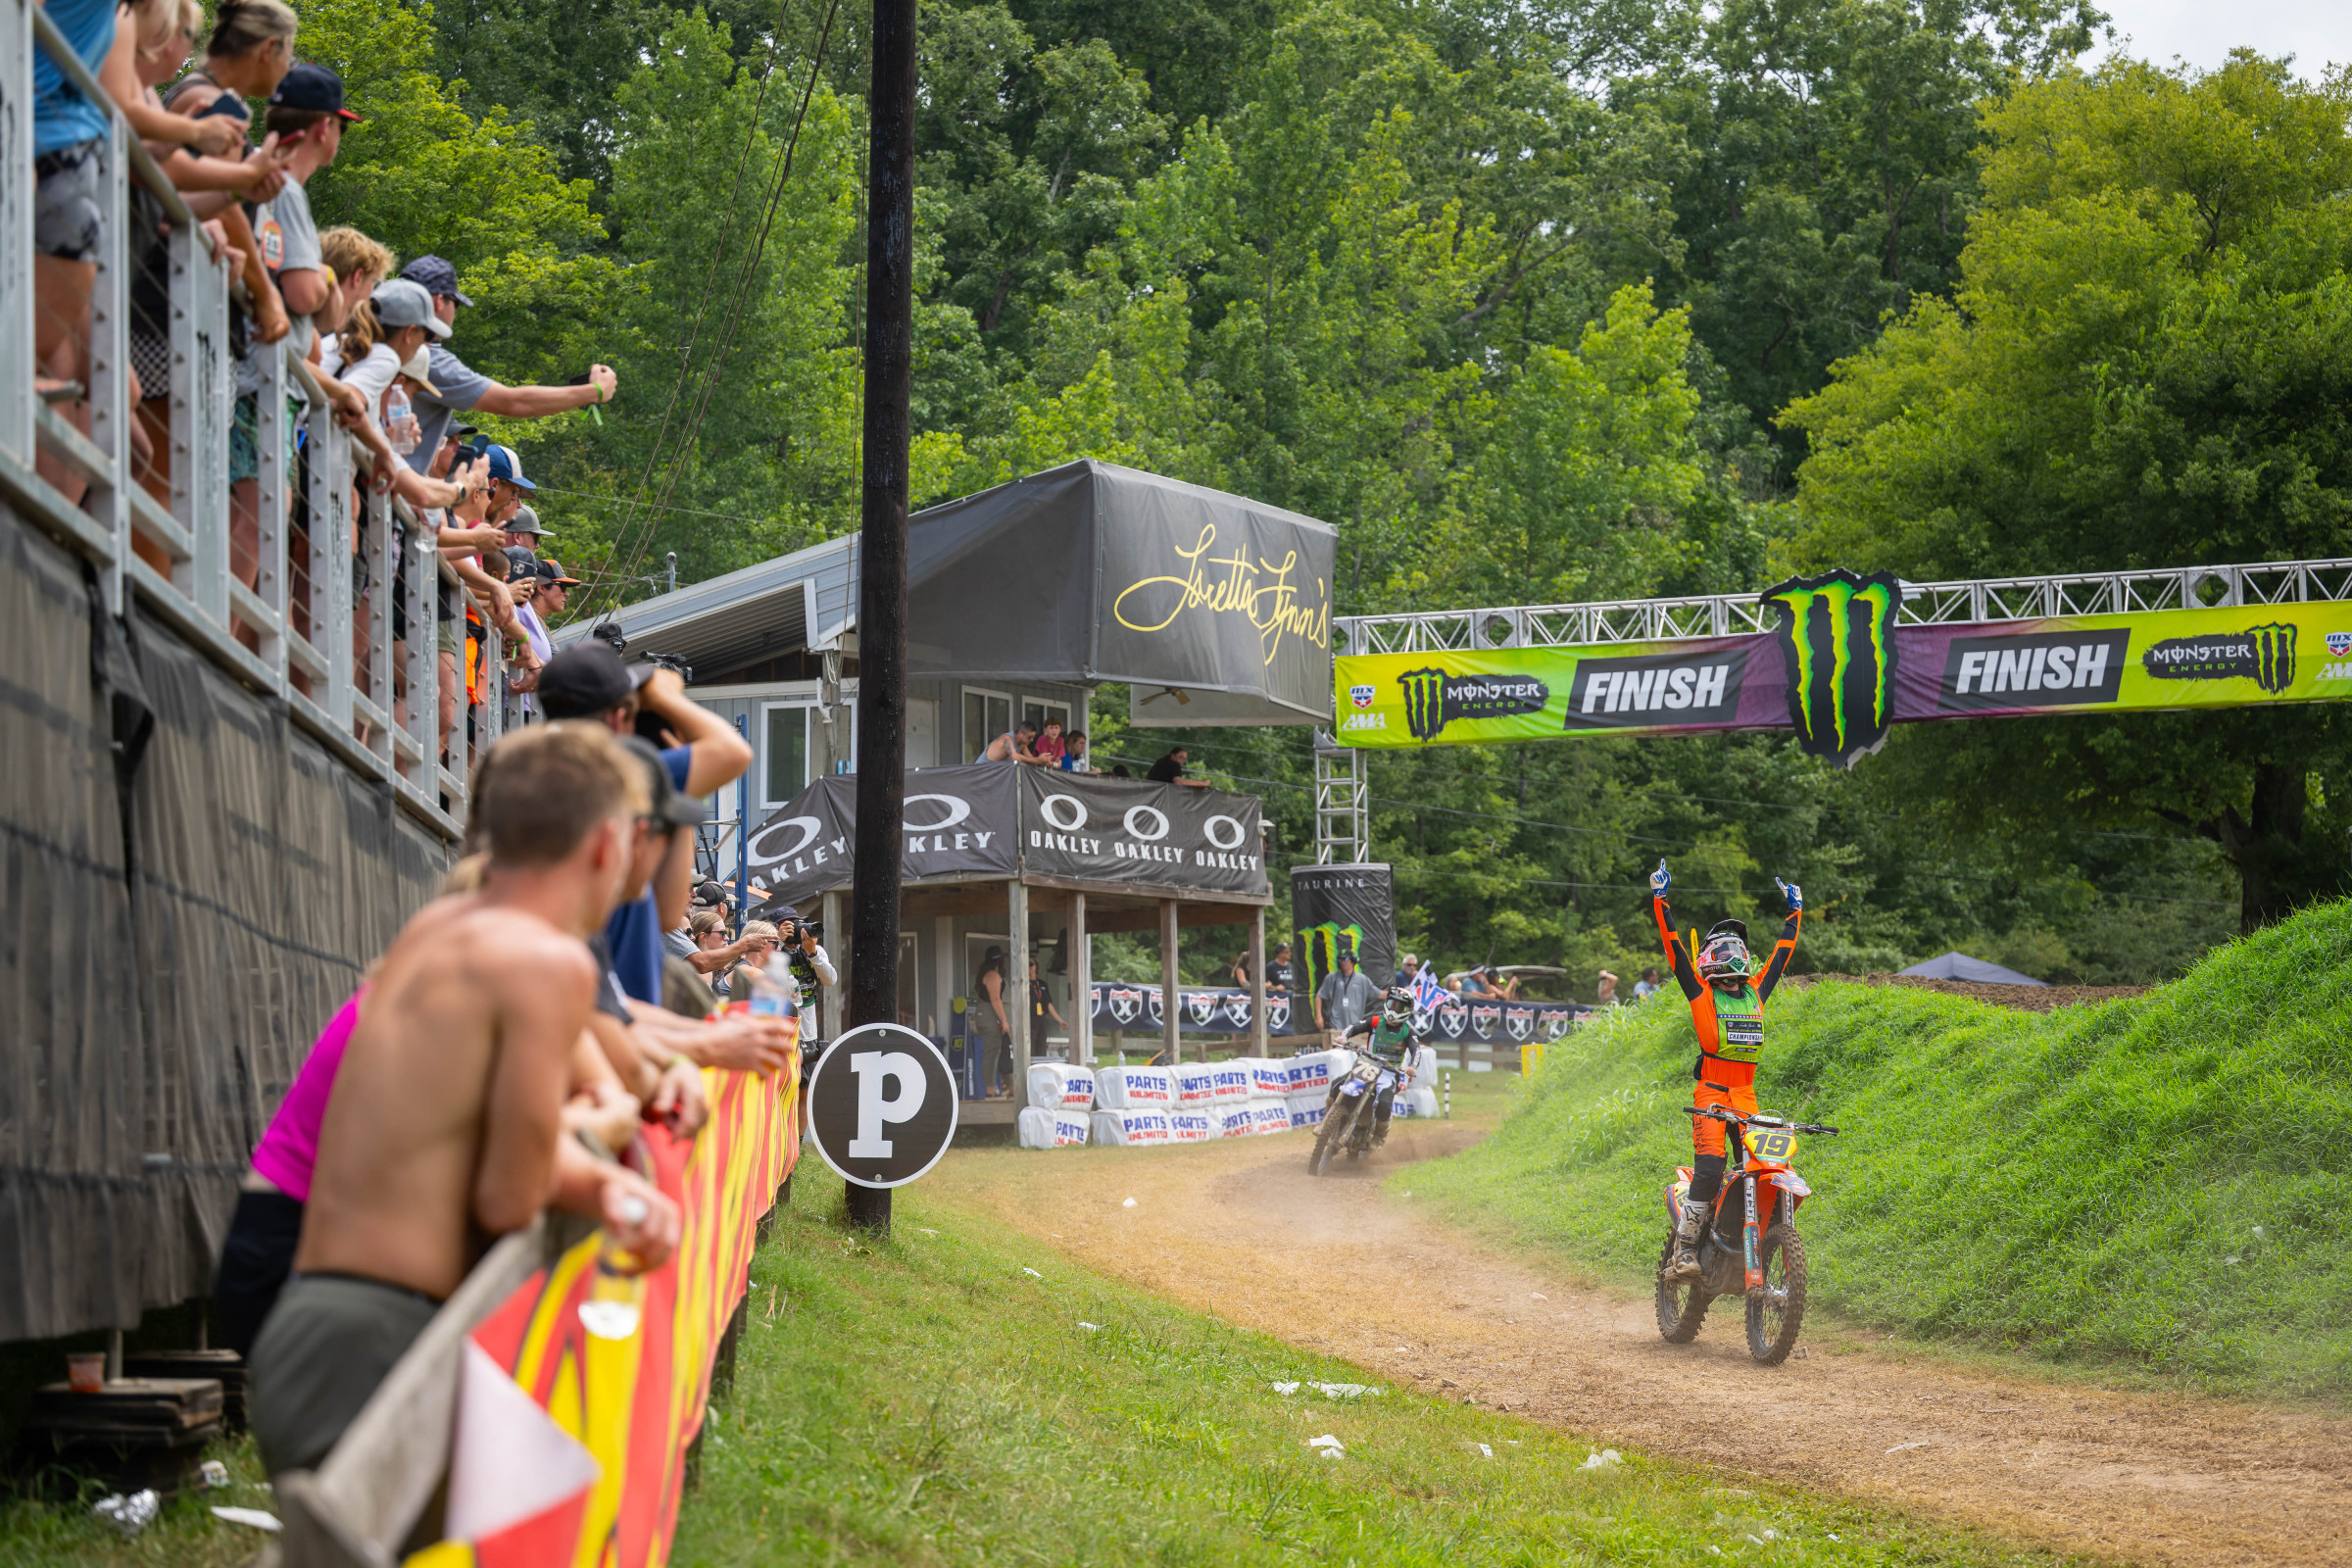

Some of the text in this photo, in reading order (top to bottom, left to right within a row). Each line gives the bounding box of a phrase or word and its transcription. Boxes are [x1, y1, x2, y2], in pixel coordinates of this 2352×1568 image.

[1114, 523, 1260, 631] Loretta
[2152, 641, 2253, 662] MONSTER
[1955, 643, 2111, 695] FINISH
[2169, 661, 2237, 672] ENERGY
[1446, 681, 1542, 702] MONSTER
[1581, 664, 1730, 714] FINISH
[1462, 700, 1528, 711] ENERGY
[1343, 712, 1388, 730] AMA
[908, 831, 993, 854] KLEY
[1030, 830, 1101, 856] OAKLEY
[1114, 841, 1184, 863] OAKLEY
[751, 836, 846, 890] AKLEY
[1196, 850, 1258, 871] OAKLEY
[1297, 878, 1365, 891] TAURINE
[1125, 1075, 1167, 1091] PARTS
[1124, 1116, 1167, 1132] PARTS
[1754, 1134, 1790, 1157] 19
